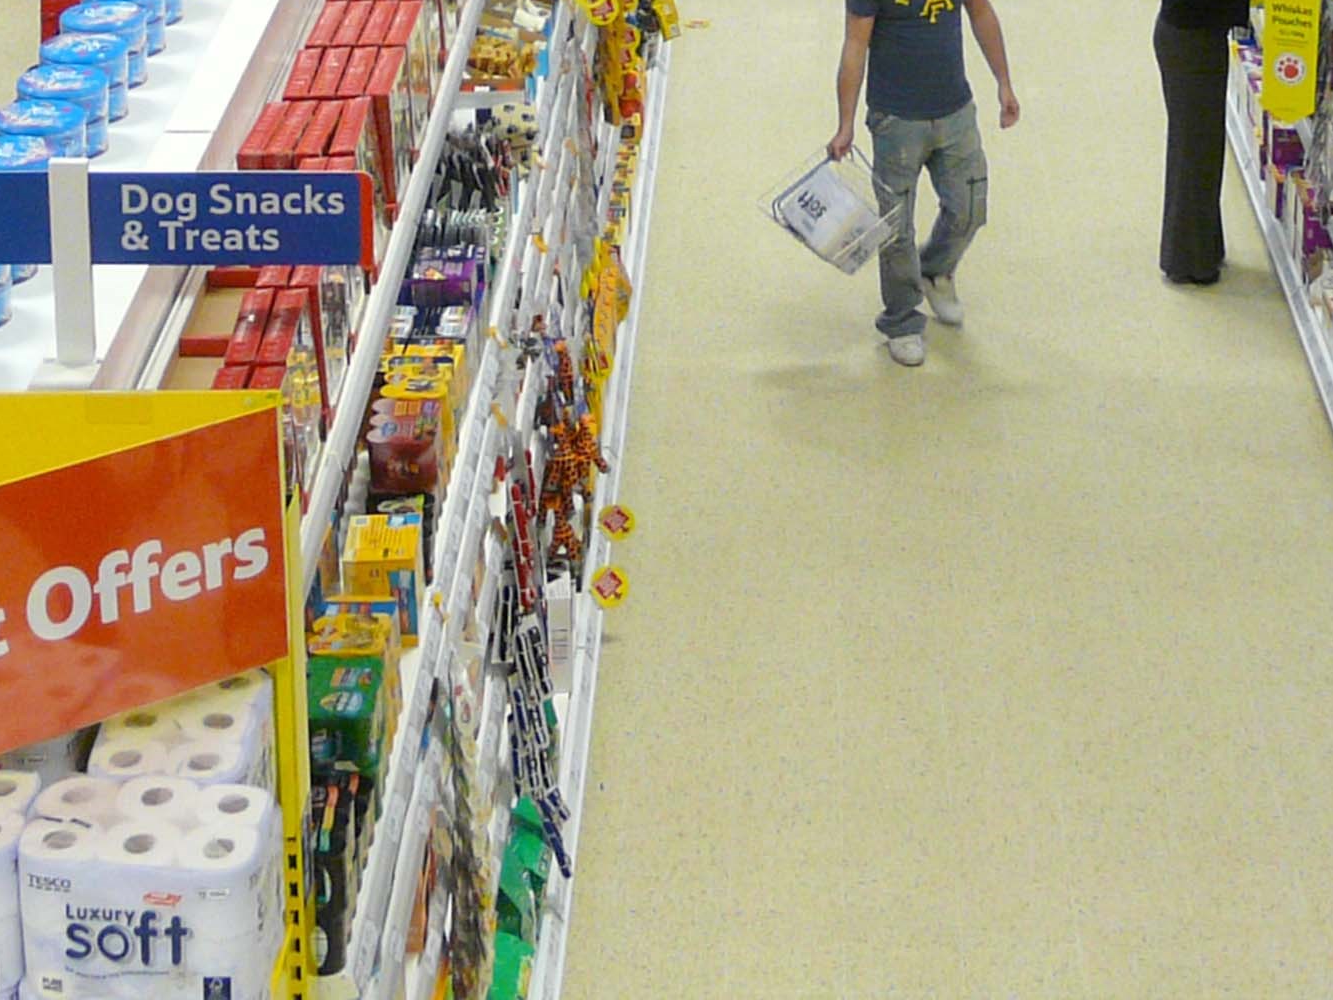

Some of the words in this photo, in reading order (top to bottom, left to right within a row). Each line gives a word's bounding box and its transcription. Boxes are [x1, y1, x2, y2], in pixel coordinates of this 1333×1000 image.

[120, 183, 197, 220] Dog
[209, 184, 345, 216] Snacks
[120, 222, 150, 252] &
[159, 220, 280, 252] Treats
[26, 527, 269, 643] Offers
[28, 874, 71, 890] TESCO
[66, 903, 134, 927] Luxury
[66, 910, 187, 966] soft
